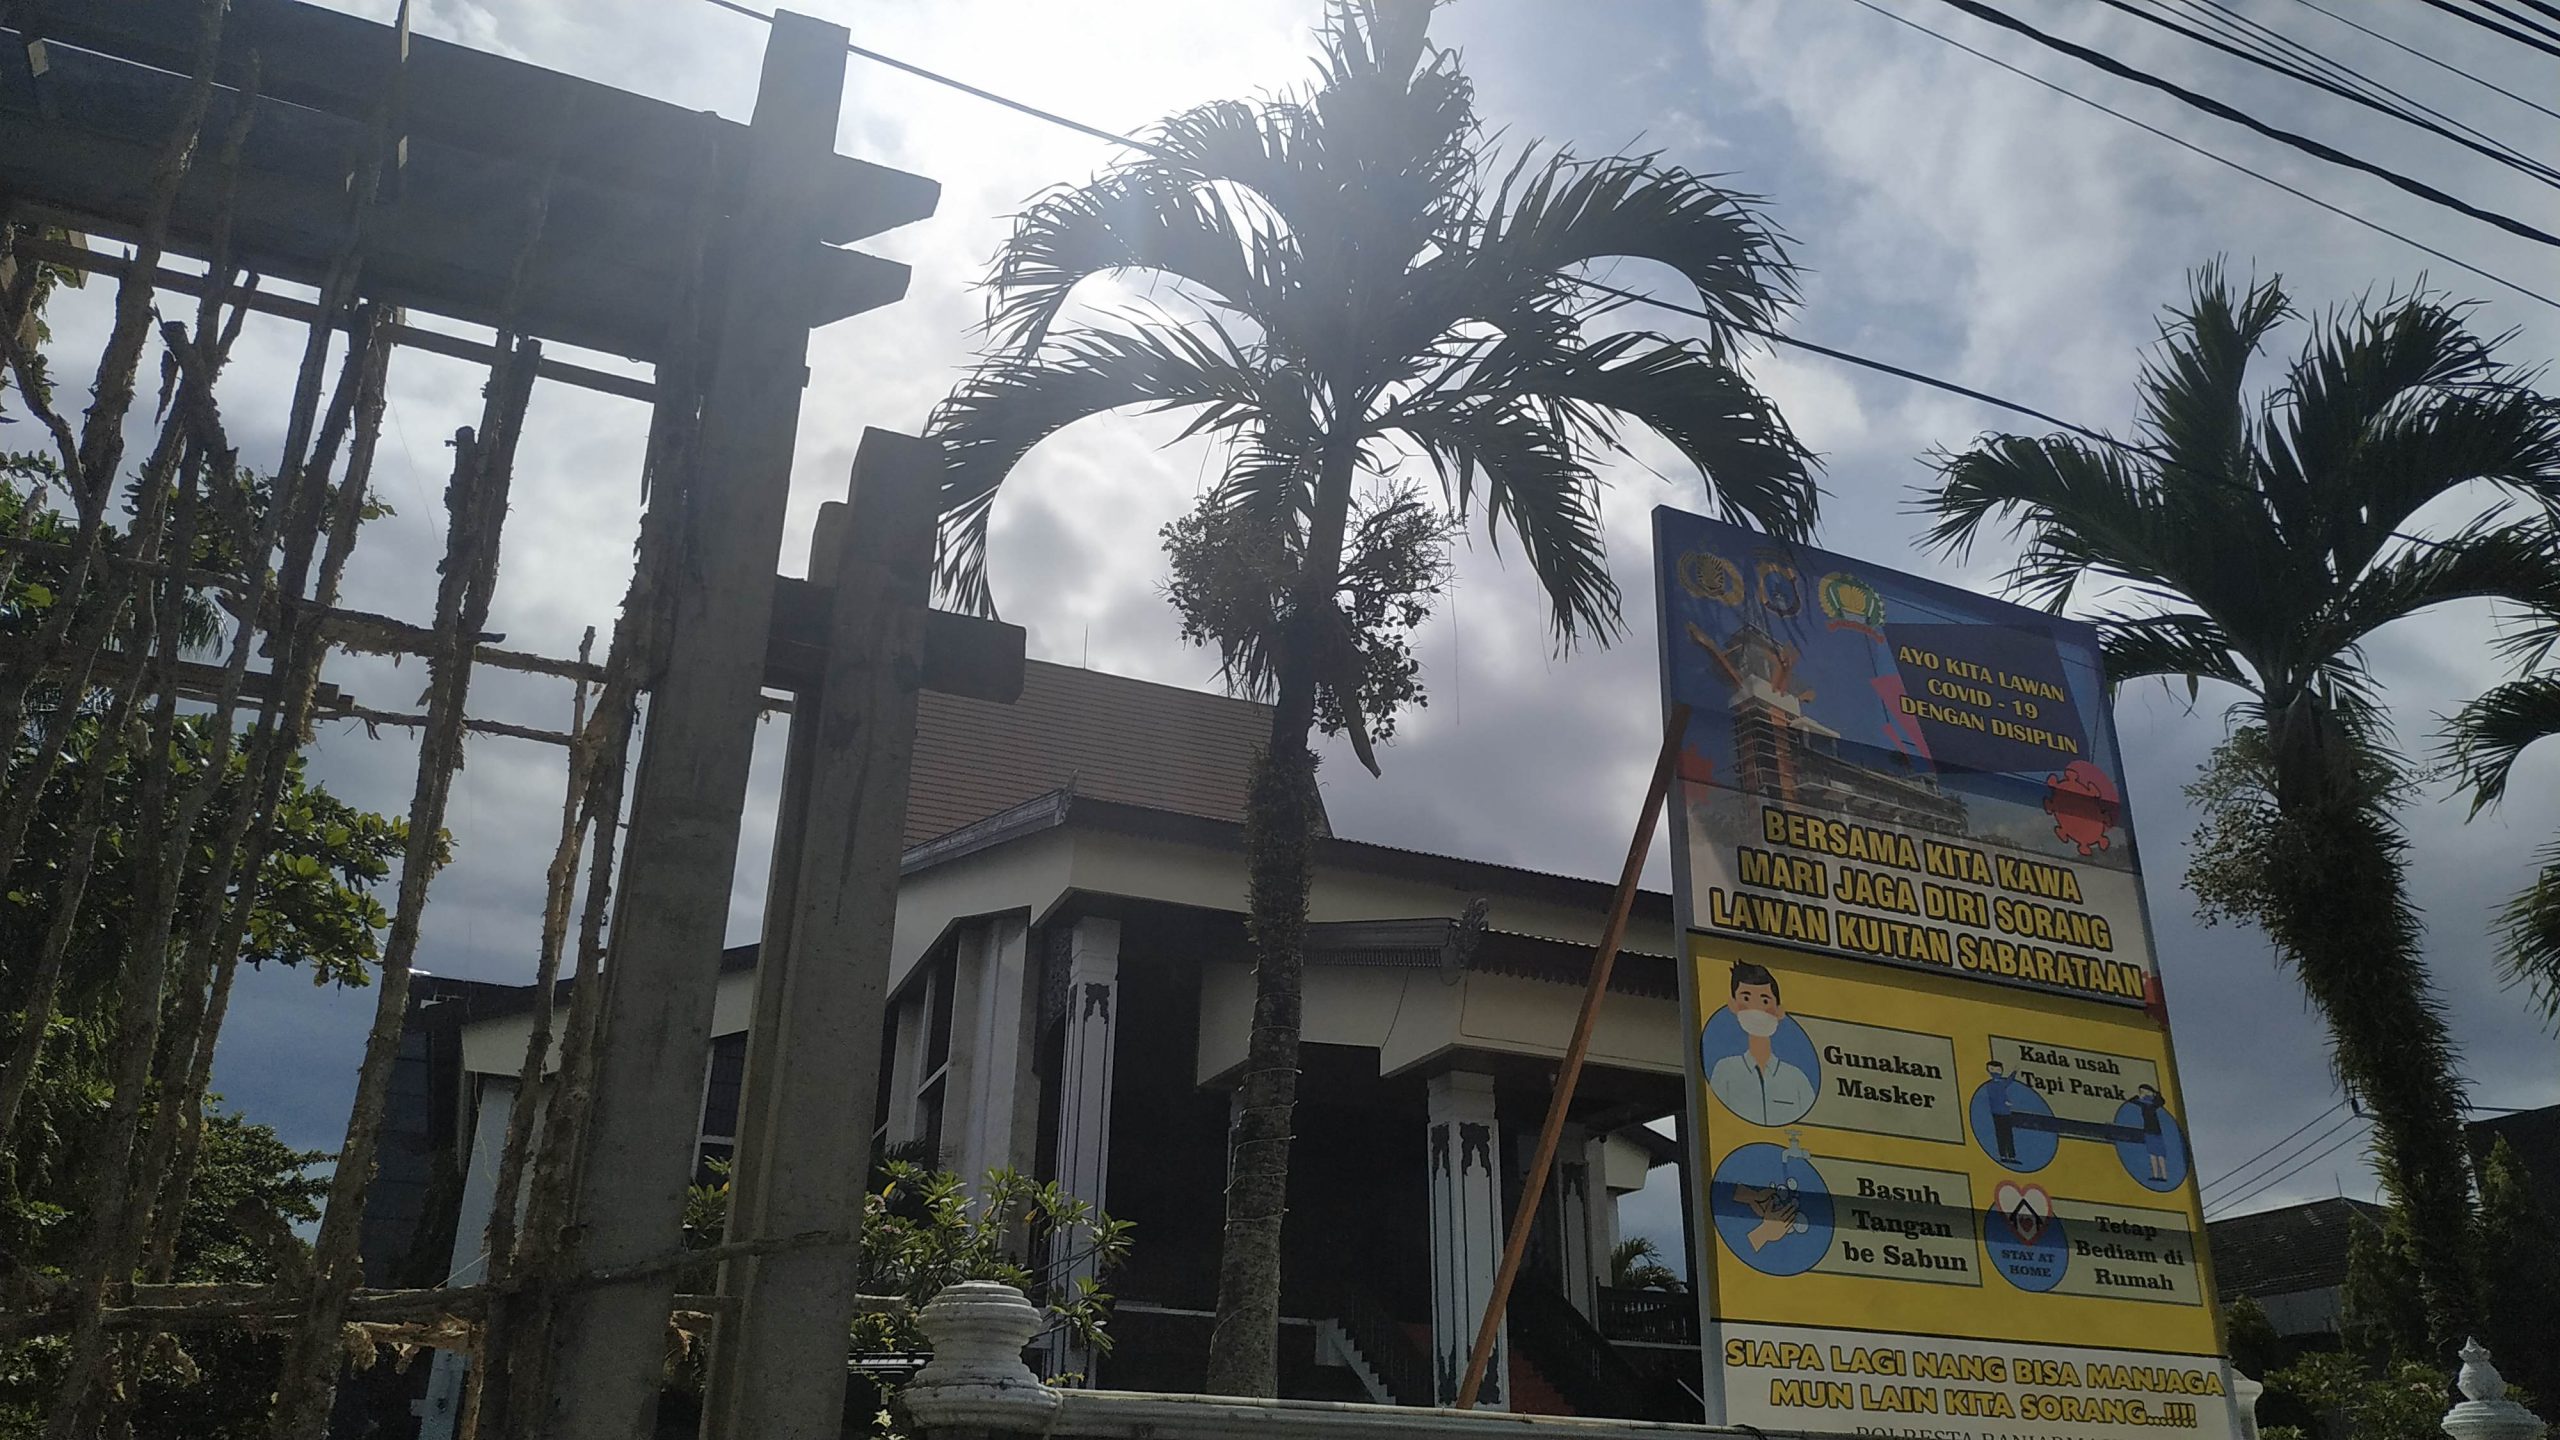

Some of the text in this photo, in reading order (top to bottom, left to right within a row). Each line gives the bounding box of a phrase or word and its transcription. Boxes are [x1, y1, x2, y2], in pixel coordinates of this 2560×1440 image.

[1900, 646, 2065, 702] AYO KITA LAWAN
[1928, 678, 1992, 708] COVID
[2012, 700, 2038, 719] 19
[1900, 696, 2078, 754] DENGAN DISIPLIN
[1762, 805, 2083, 905] BERSAMA KITA KAWA
[1737, 846, 2113, 952] MARI JAGA DIRI SORANG
[1709, 887, 2145, 1001] LAWAN KUITAN SABARATAAN
[1823, 1045, 1942, 1079] Gunakan
[2019, 1045, 2121, 1075] Kada usah
[1836, 1077, 1935, 1108] Masker
[2021, 1071, 2128, 1101] Tapi Parak
[1856, 1177, 1942, 1205] Basuh
[1851, 1208, 1954, 1240] Tangan
[2095, 1215, 2157, 1242] Tetap
[1842, 1241, 1968, 1271] be Sabun
[2002, 1250, 2055, 1263] STAY AT
[2075, 1239, 2186, 1266] Bediam di
[2010, 1265, 2051, 1277] HOME
[2095, 1268, 2174, 1291] Rumah
[1725, 1338, 2226, 1397] SIAPA LAGI NANG BISA MANJAGA
[1770, 1379, 1854, 1409] MUN
[1861, 1384, 1938, 1414] LAIN
[1944, 1389, 2015, 1418] KITA
